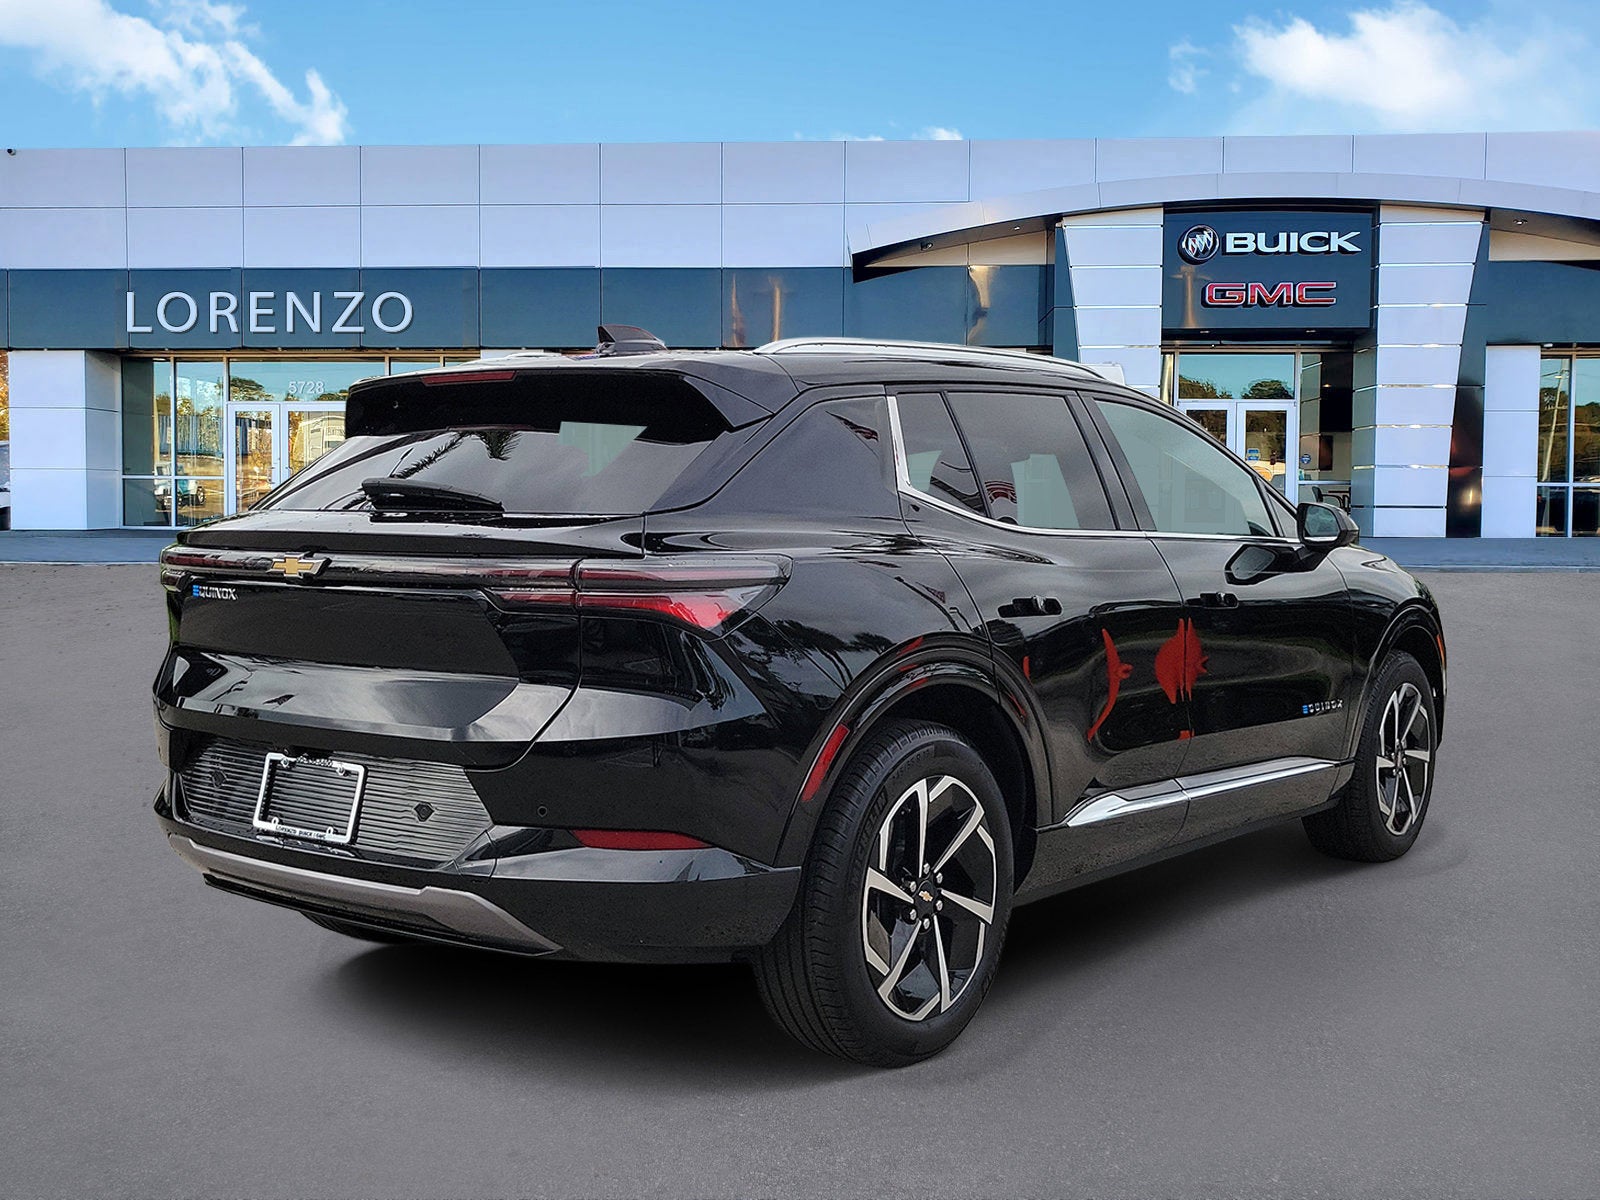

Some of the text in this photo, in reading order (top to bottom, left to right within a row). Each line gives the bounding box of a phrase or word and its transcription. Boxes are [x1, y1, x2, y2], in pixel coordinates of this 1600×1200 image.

[1225, 231, 1361, 253] BUICK
[1206, 282, 1337, 305] GMC
[126, 291, 413, 333] LORENZO
[288, 380, 325, 394] 5728
[192, 584, 236, 600] EQUINOX
